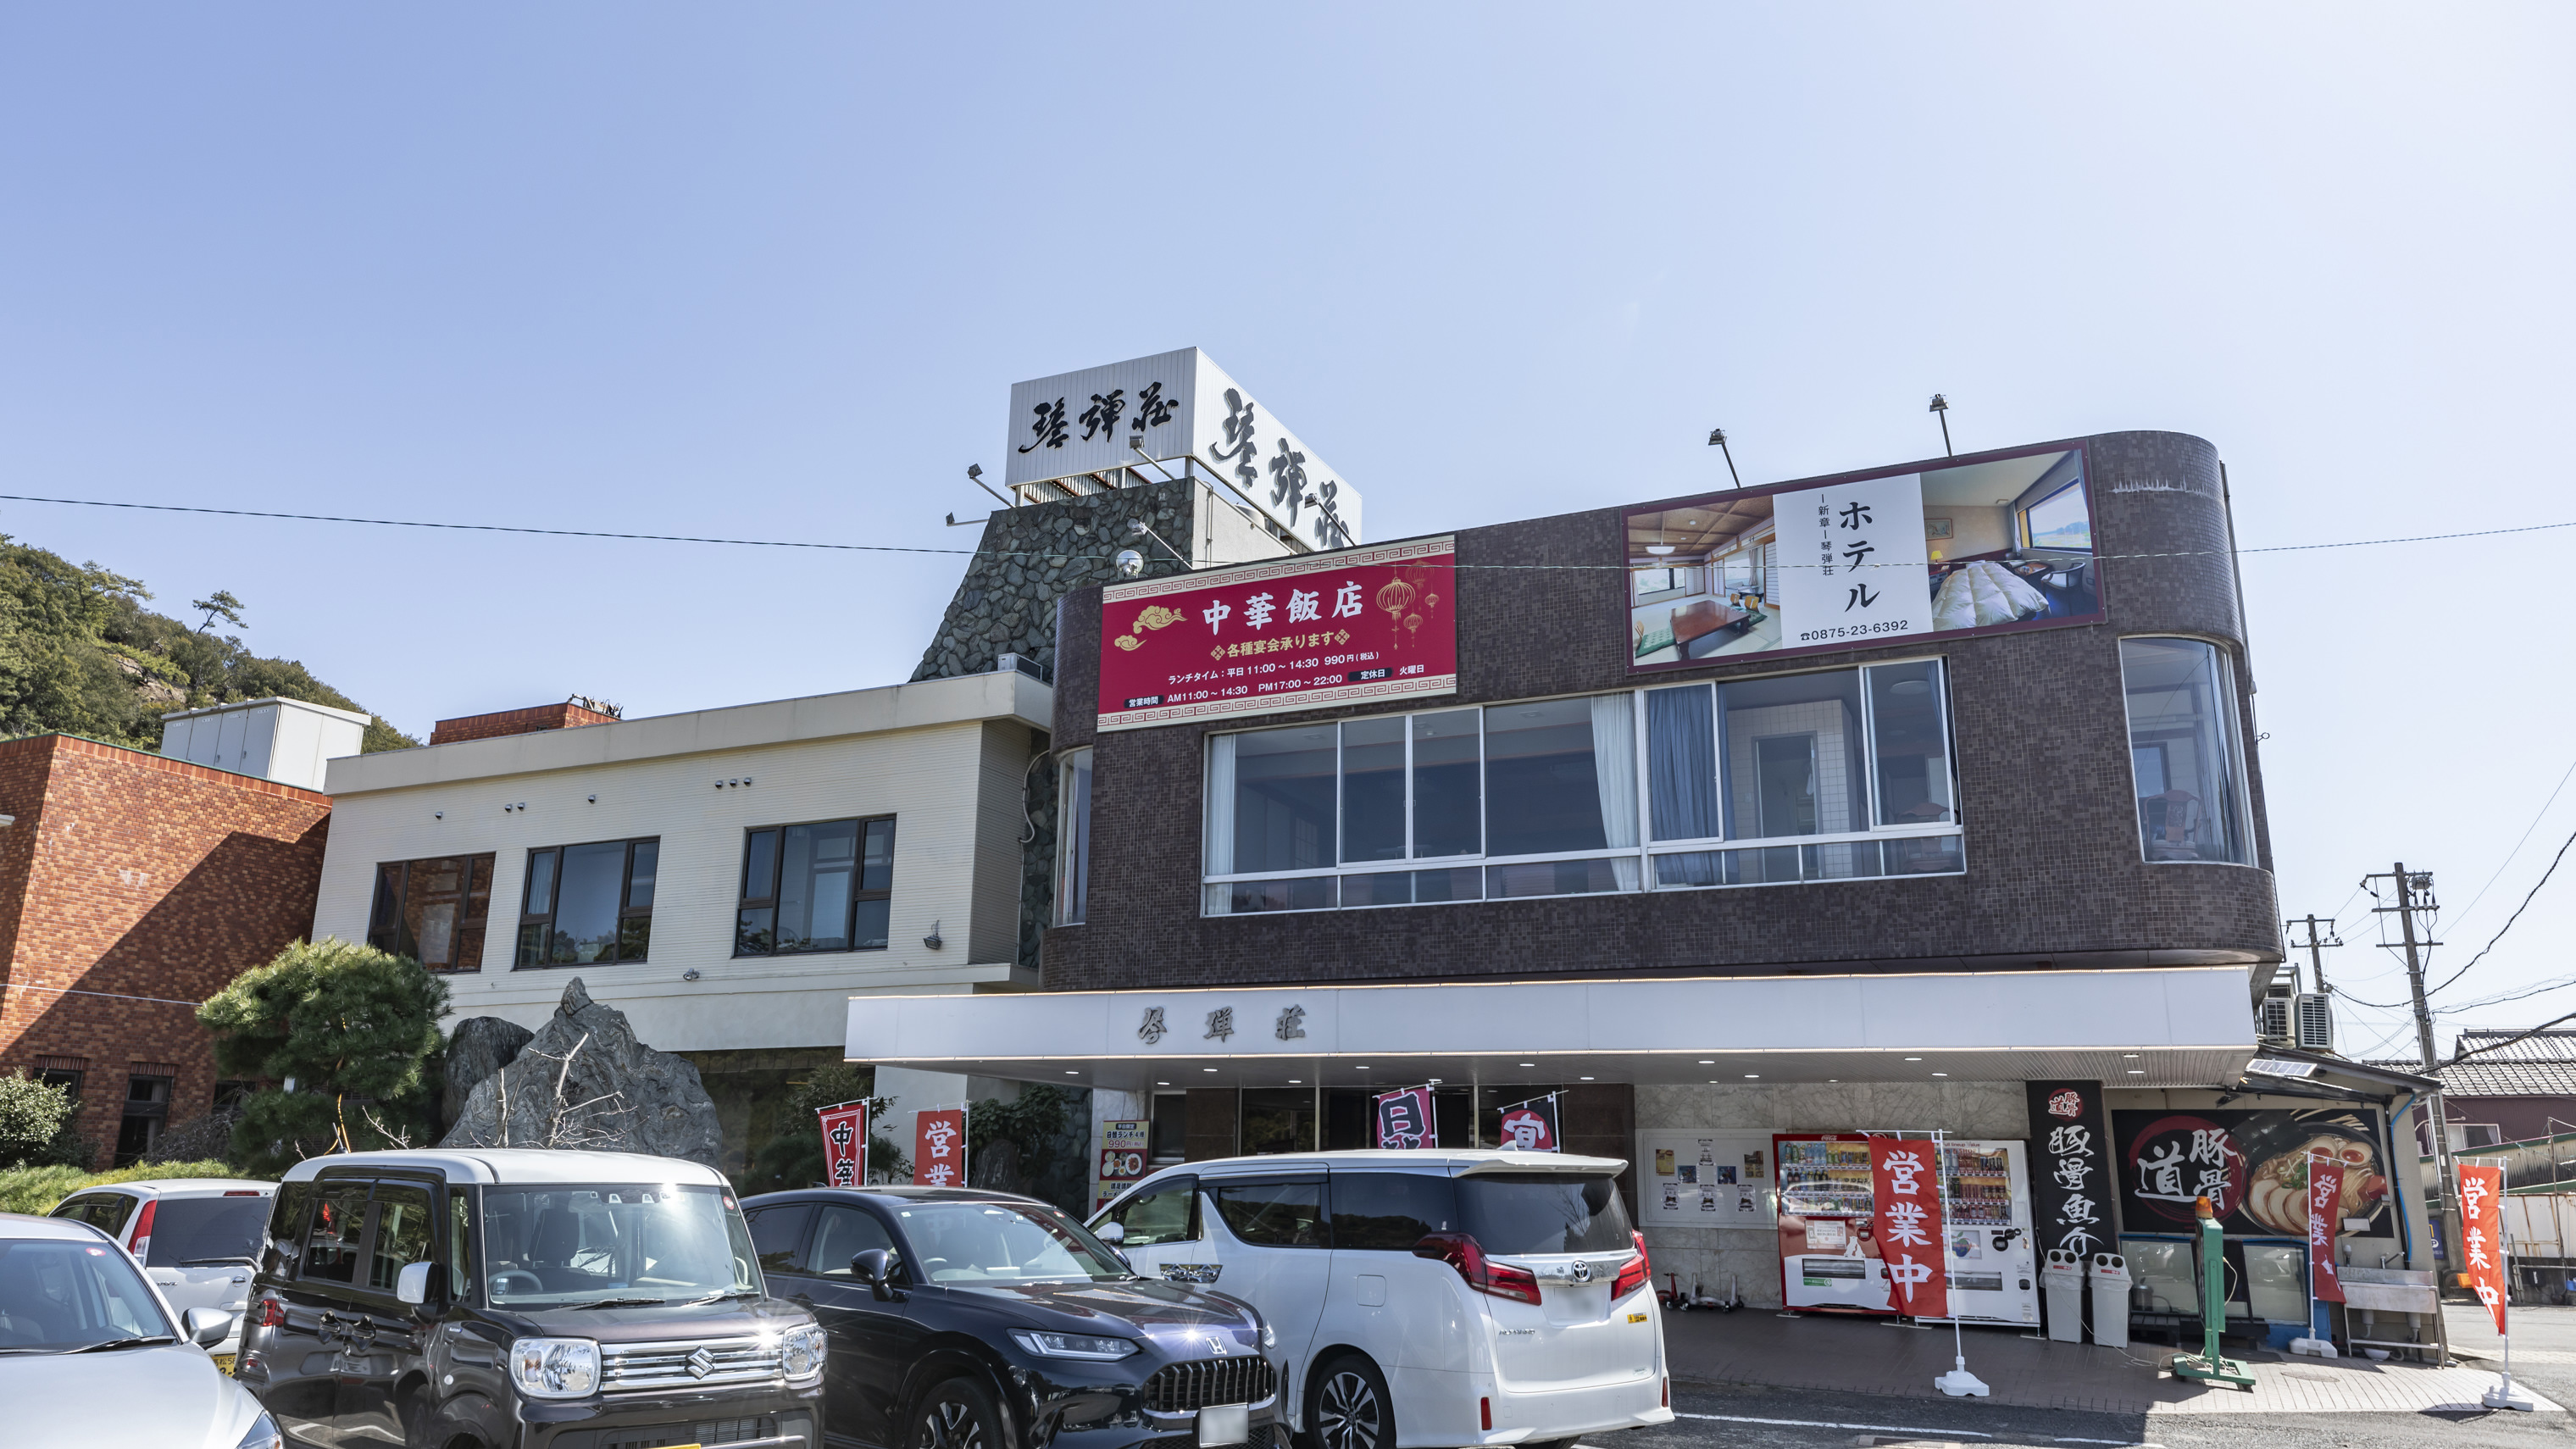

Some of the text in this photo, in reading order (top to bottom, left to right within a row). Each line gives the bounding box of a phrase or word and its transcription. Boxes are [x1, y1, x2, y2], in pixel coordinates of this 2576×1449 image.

[1840, 502, 1880, 613] ホテル
[1202, 580, 1363, 636] 中華飯店
[1227, 631, 1335, 658] 各種宴会承ります
[1129, 696, 1158, 708] 営業時間
[1360, 669, 1385, 680] 定休日
[1399, 664, 1424, 675] 火曜日
[1882, 1150, 1934, 1303] 営業中
[2462, 1176, 2500, 1324] 営業中
